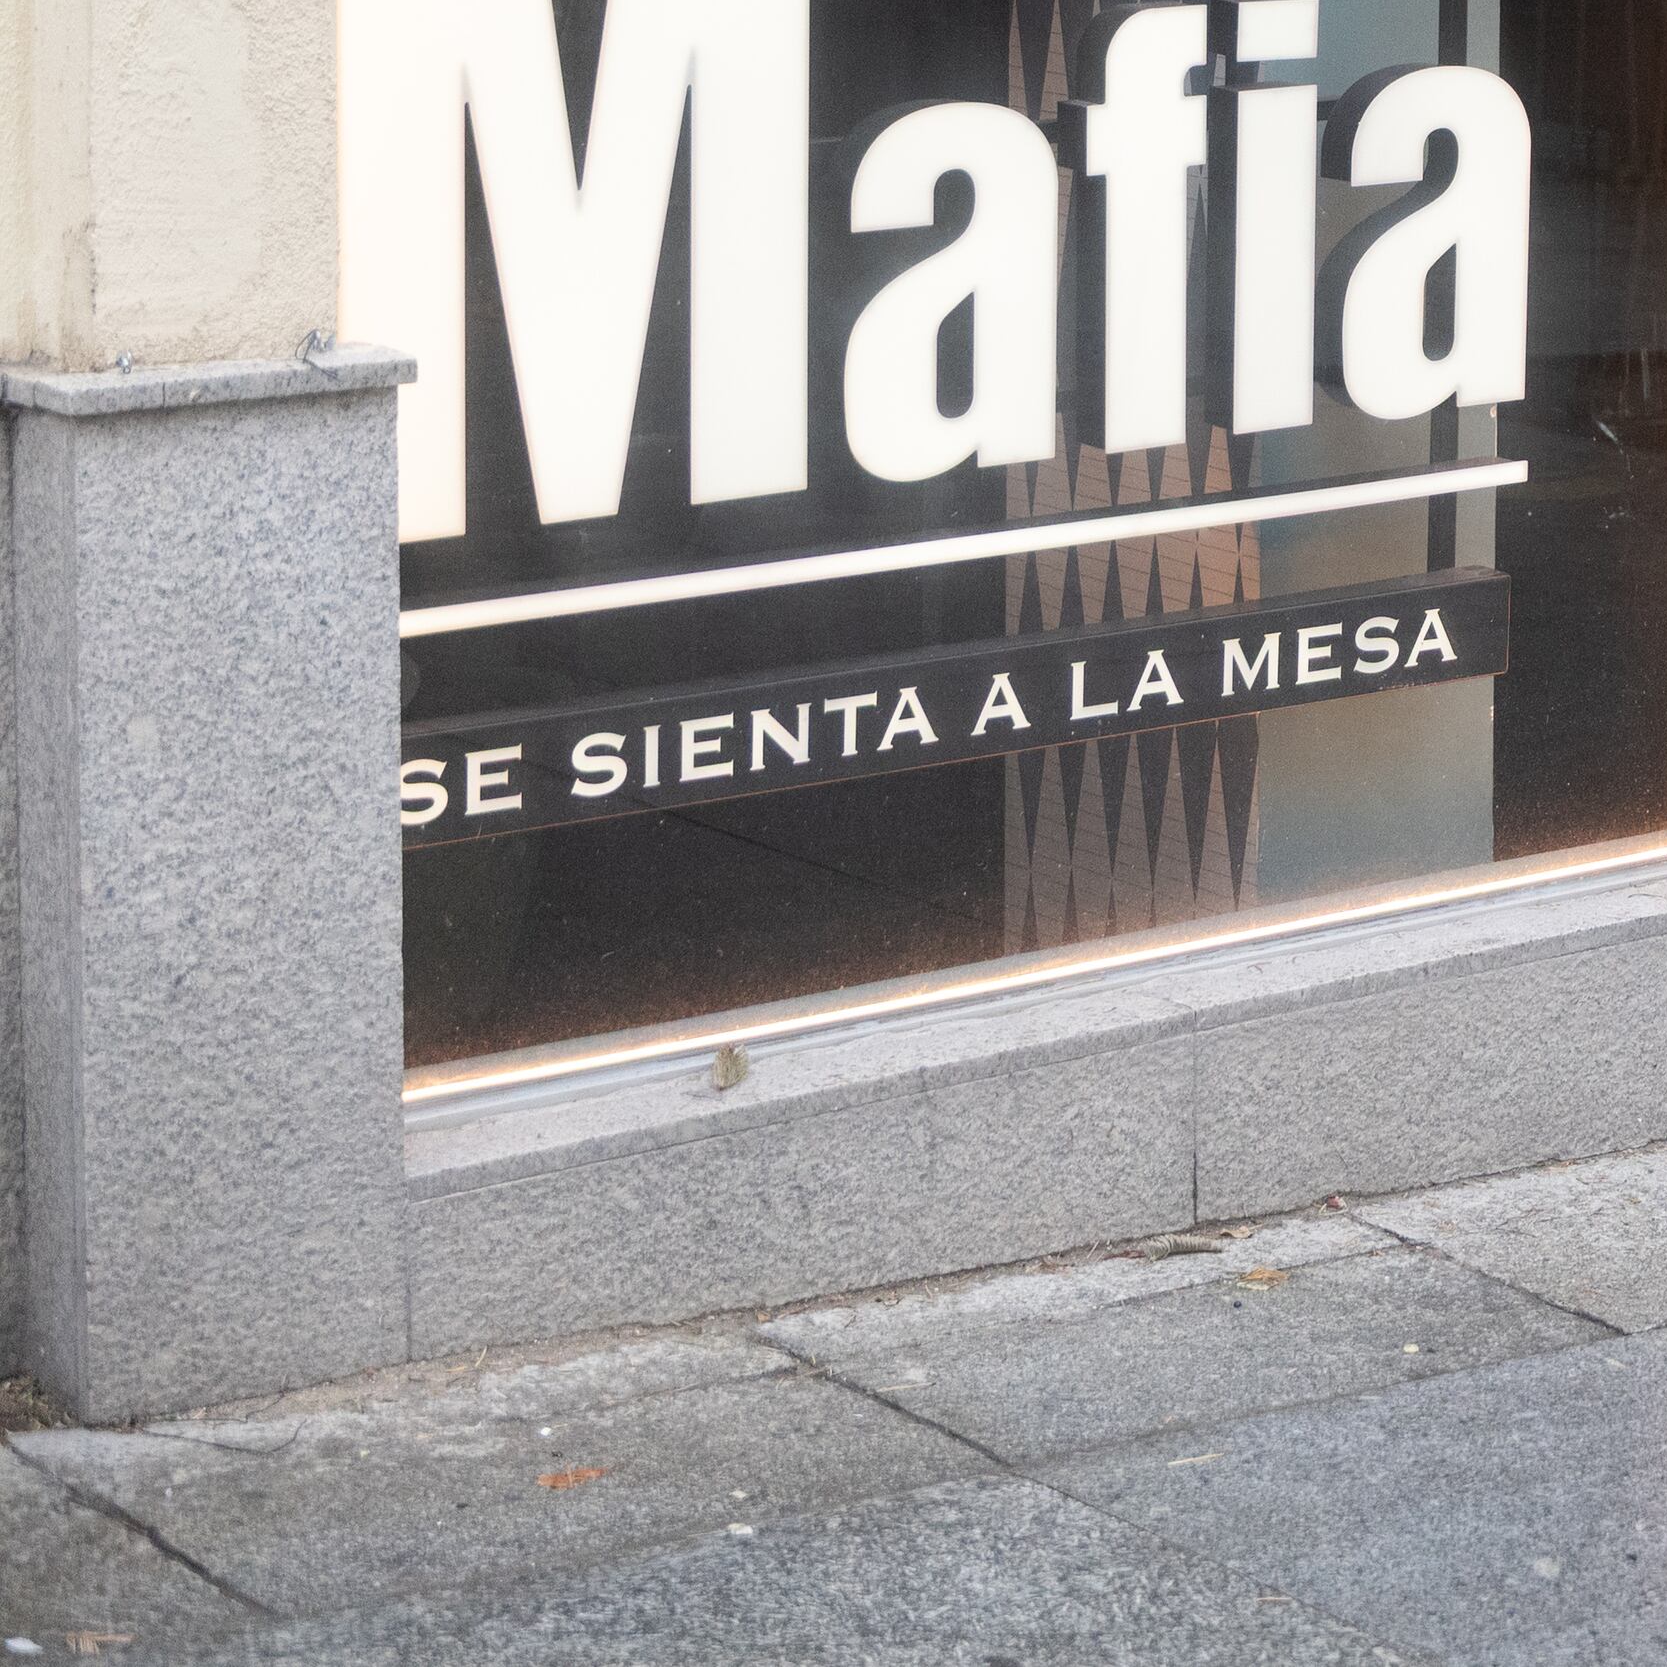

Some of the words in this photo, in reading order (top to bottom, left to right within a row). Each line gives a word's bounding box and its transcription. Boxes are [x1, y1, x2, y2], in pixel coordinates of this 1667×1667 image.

[401, 744, 523, 826] SE
[570, 686, 939, 798] SIENTA
[970, 672, 1032, 737] A
[1069, 649, 1184, 722] LA
[1221, 607, 1458, 698] MESA
